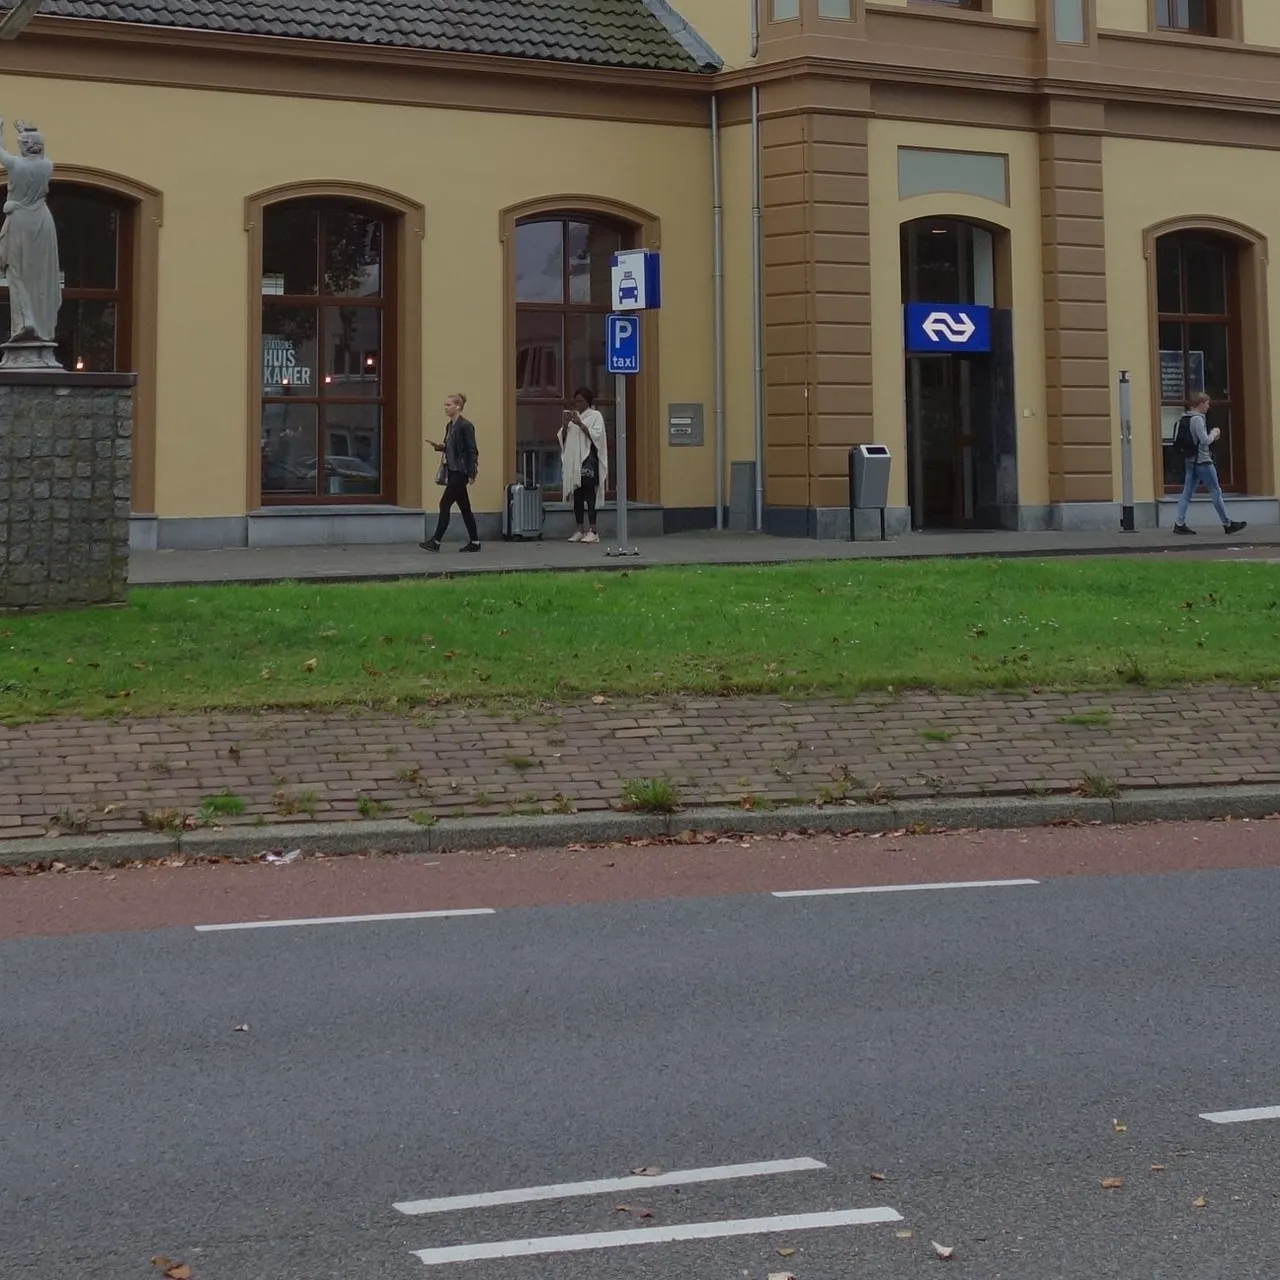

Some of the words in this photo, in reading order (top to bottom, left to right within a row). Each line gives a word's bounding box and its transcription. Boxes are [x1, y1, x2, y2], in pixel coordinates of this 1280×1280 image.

[615, 320, 632, 348] P
[264, 349, 296, 367] HUIS
[612, 355, 635, 367] taxi
[264, 366, 311, 385] KAMER
